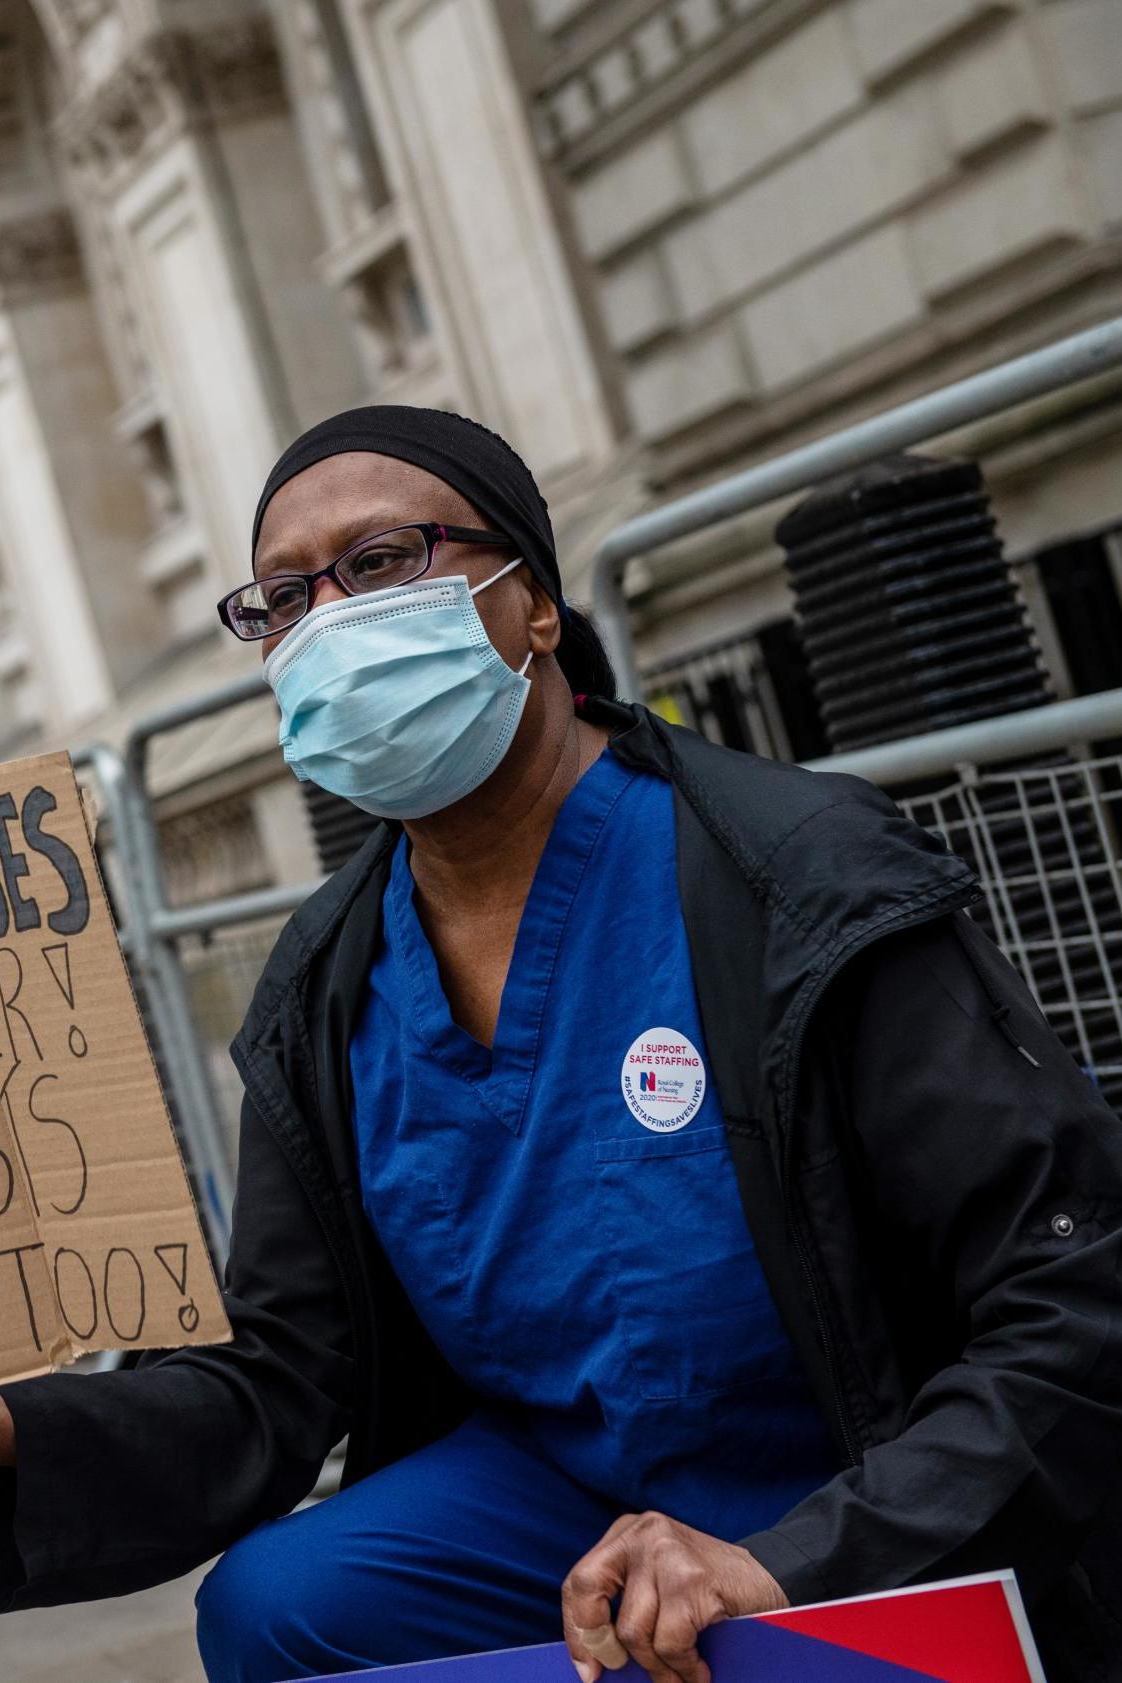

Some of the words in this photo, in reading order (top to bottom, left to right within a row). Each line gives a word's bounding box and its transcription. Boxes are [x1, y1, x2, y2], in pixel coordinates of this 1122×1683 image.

[646, 1044, 687, 1055] SUPPORT
[629, 1055, 653, 1065] SAFE
[655, 1056, 699, 1067] STAFFING
[624, 1075, 703, 1128] #SAFESTAFFINGSAVESLIVES
[639, 1094, 656, 1102] 2020
